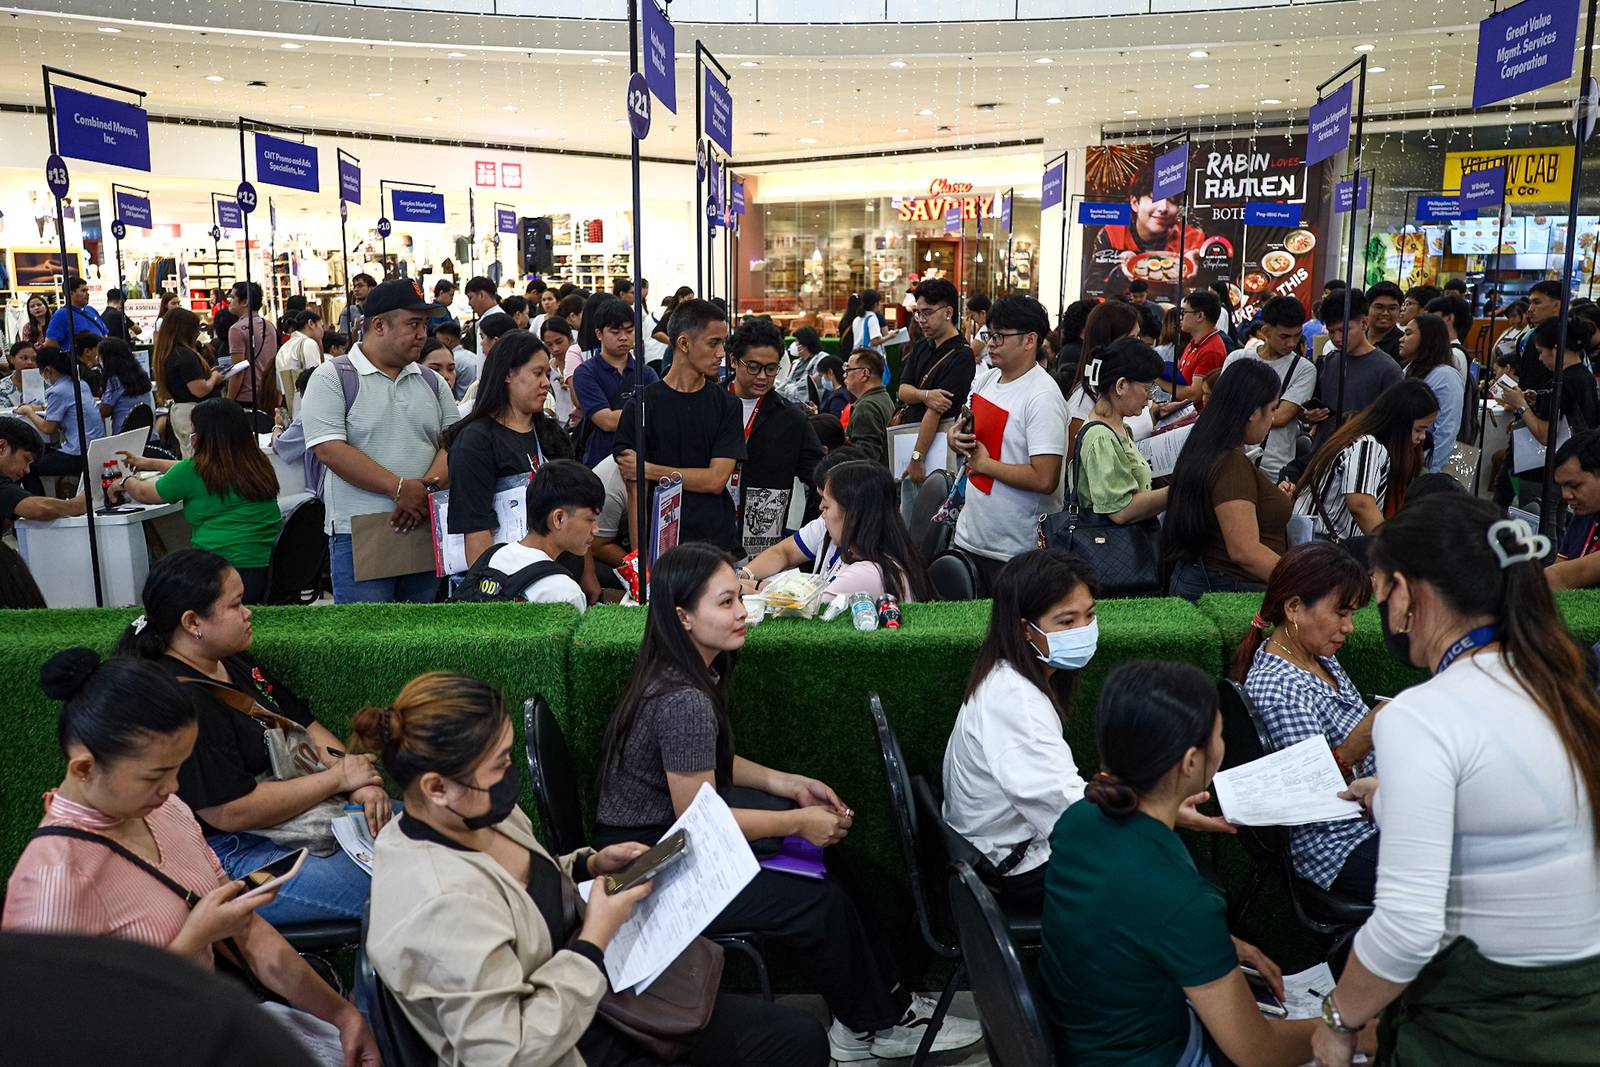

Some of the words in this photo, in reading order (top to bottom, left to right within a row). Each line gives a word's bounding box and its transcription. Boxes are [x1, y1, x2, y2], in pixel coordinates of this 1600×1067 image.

[1505, 22, 1530, 42] Great
[1529, 13, 1552, 33] Value
[1496, 45, 1522, 64] Mgmt.
[1522, 31, 1557, 54] Services
[1500, 53, 1548, 80] Corporation
[629, 90, 649, 120] #21
[74, 112, 112, 131] Combined
[112, 121, 138, 139] Movers,
[103, 132, 117, 145] Inc.
[264, 150, 276, 160] CNT
[275, 152, 292, 164] Promo
[301, 159, 312, 168] Ads
[269, 161, 298, 176] Specialists,
[1206, 152, 1271, 178] RABIN
[1271, 157, 1299, 168] LOVES
[1524, 153, 1560, 184] CAB
[48, 167, 67, 185] #13
[1204, 174, 1295, 199] RAMEN
[238, 191, 256, 206] #12
[897, 195, 995, 222] SAVORY
[378, 222, 390, 231] #10
[1276, 267, 1309, 297] THIS
